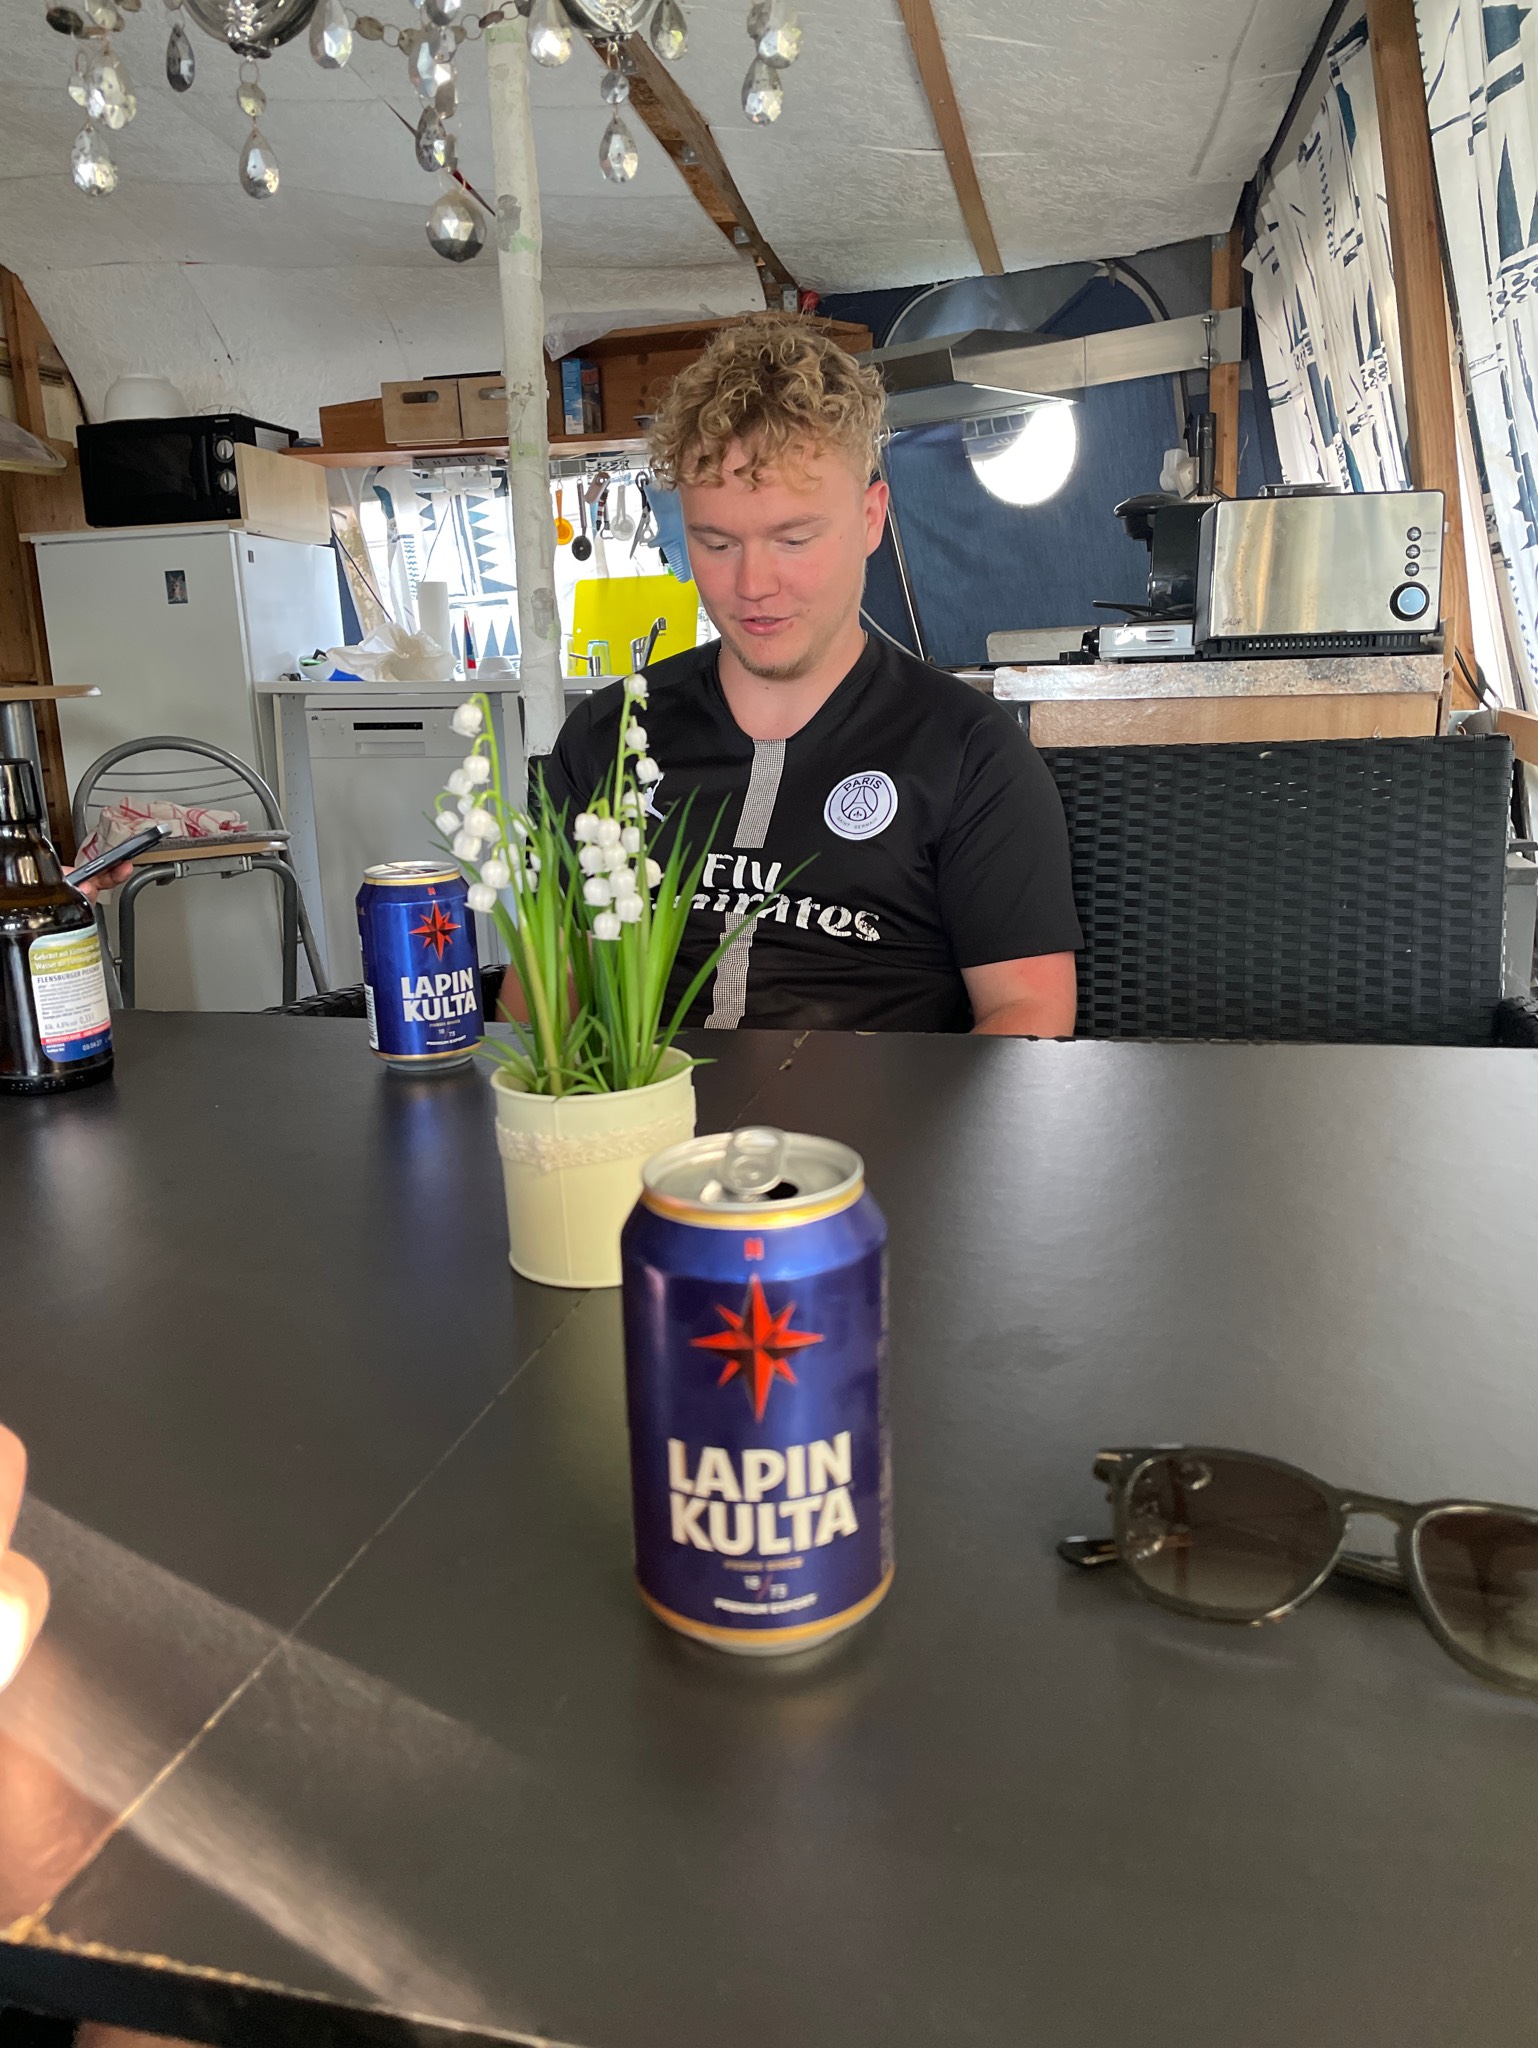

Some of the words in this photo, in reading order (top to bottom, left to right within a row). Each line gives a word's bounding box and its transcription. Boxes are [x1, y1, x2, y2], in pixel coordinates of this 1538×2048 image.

[843, 777, 882, 792] PARIS
[836, 816, 850, 827] SAINT
[853, 817, 878, 830] GERMAIN
[37, 970, 81, 984] FLENSBURGER
[400, 967, 475, 999] LAPIN
[402, 990, 478, 1022] KULTA
[667, 1430, 853, 1503] LAPIN
[669, 1485, 860, 1557] KULTA
